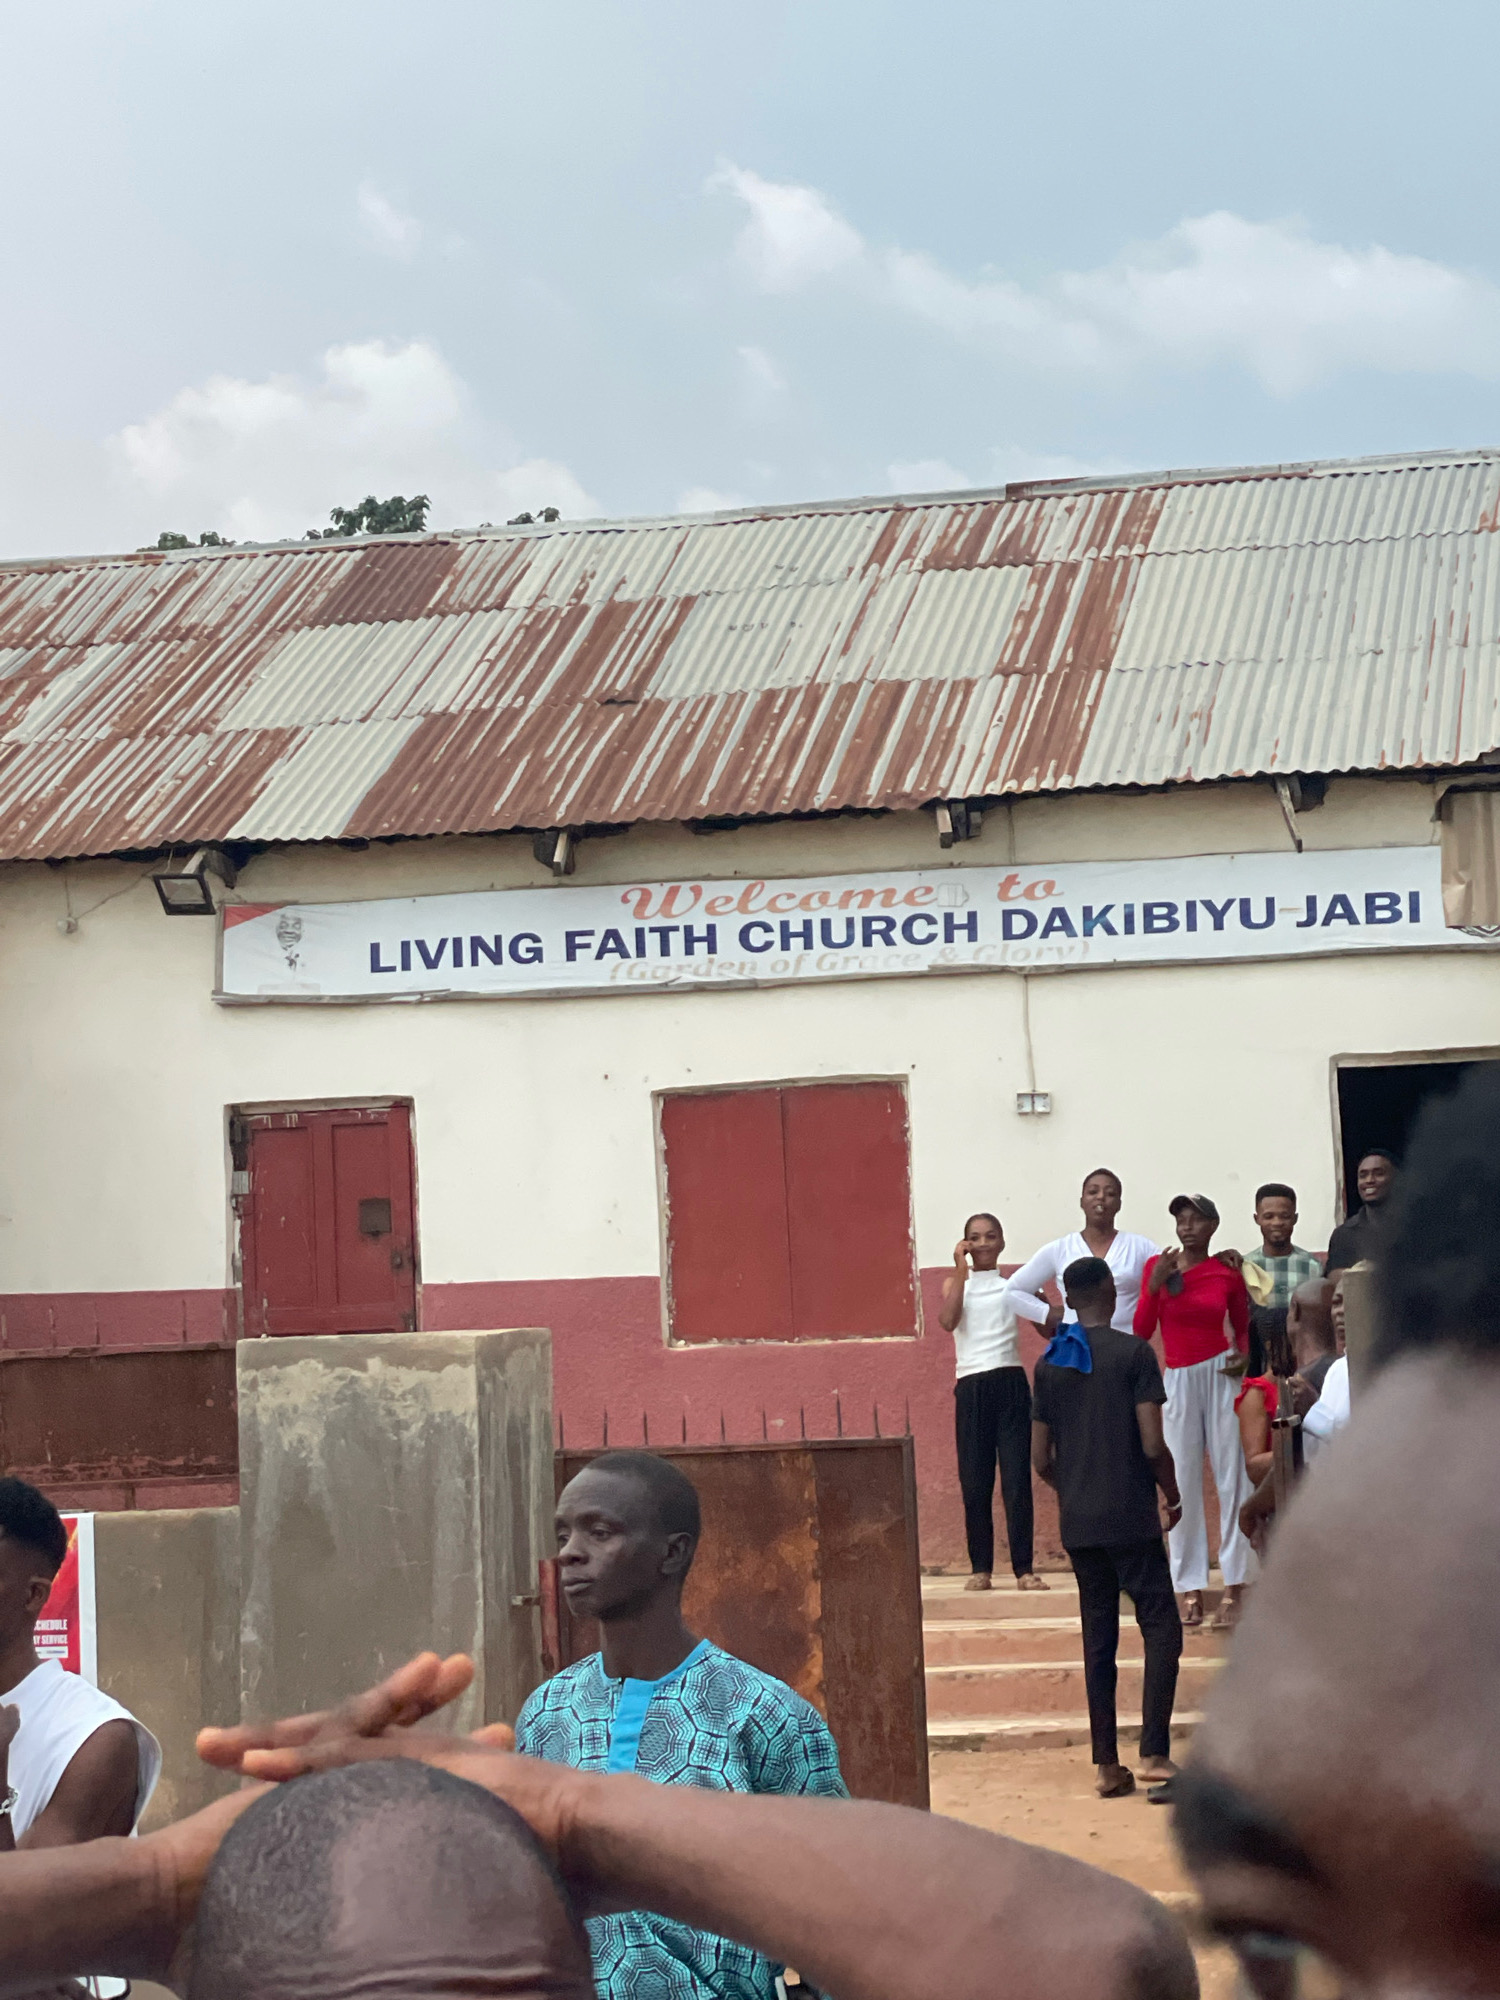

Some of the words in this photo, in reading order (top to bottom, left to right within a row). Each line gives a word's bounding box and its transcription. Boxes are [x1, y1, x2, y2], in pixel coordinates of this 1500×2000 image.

[621, 879, 938, 920] Welcome
[998, 873, 1064, 902] to
[369, 932, 544, 974] LIVING
[564, 925, 718, 963] FAITH
[738, 910, 978, 955] CHURCH
[1001, 896, 1276, 941] DAKIBIYU
[770, 951, 810, 976] of
[814, 951, 922, 972] Grace
[931, 945, 961, 964] &
